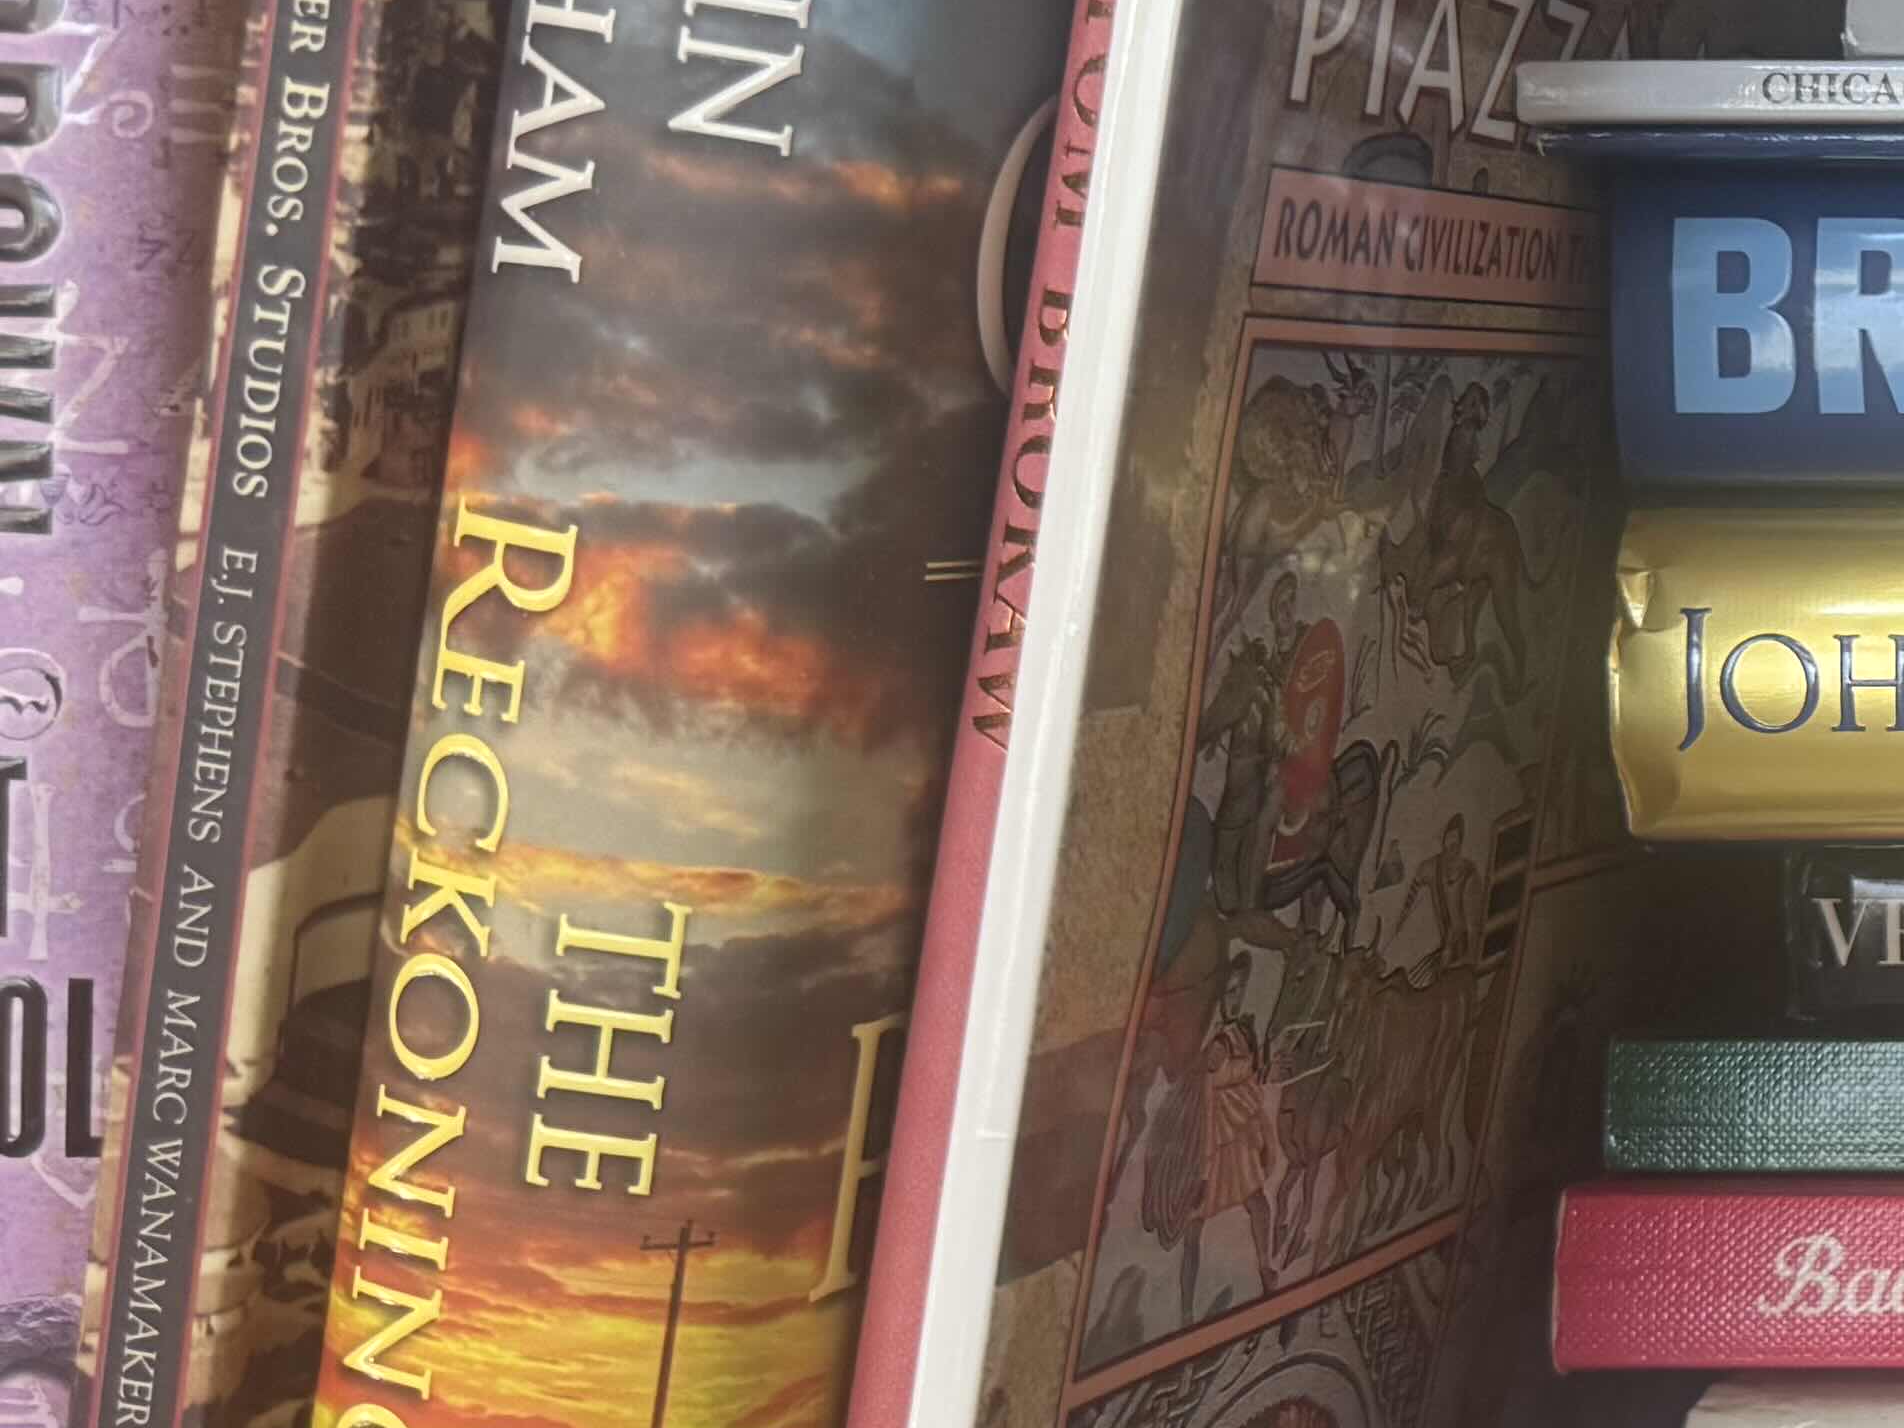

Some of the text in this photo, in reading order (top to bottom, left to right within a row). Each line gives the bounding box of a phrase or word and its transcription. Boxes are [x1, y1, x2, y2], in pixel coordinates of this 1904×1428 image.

[264, 76, 331, 238] BROS.
[1275, 197, 1397, 269] ROMAN
[1404, 215, 1559, 283] CIVILIZATION
[232, 264, 306, 499] STUDIOS
[211, 548, 259, 603] E.J.
[186, 621, 248, 844] STEPHENS
[171, 865, 213, 969] AND
[150, 988, 203, 1126] MARC
[525, 903, 692, 1196] THE
[114, 1138, 185, 1428] WANAMAKER
